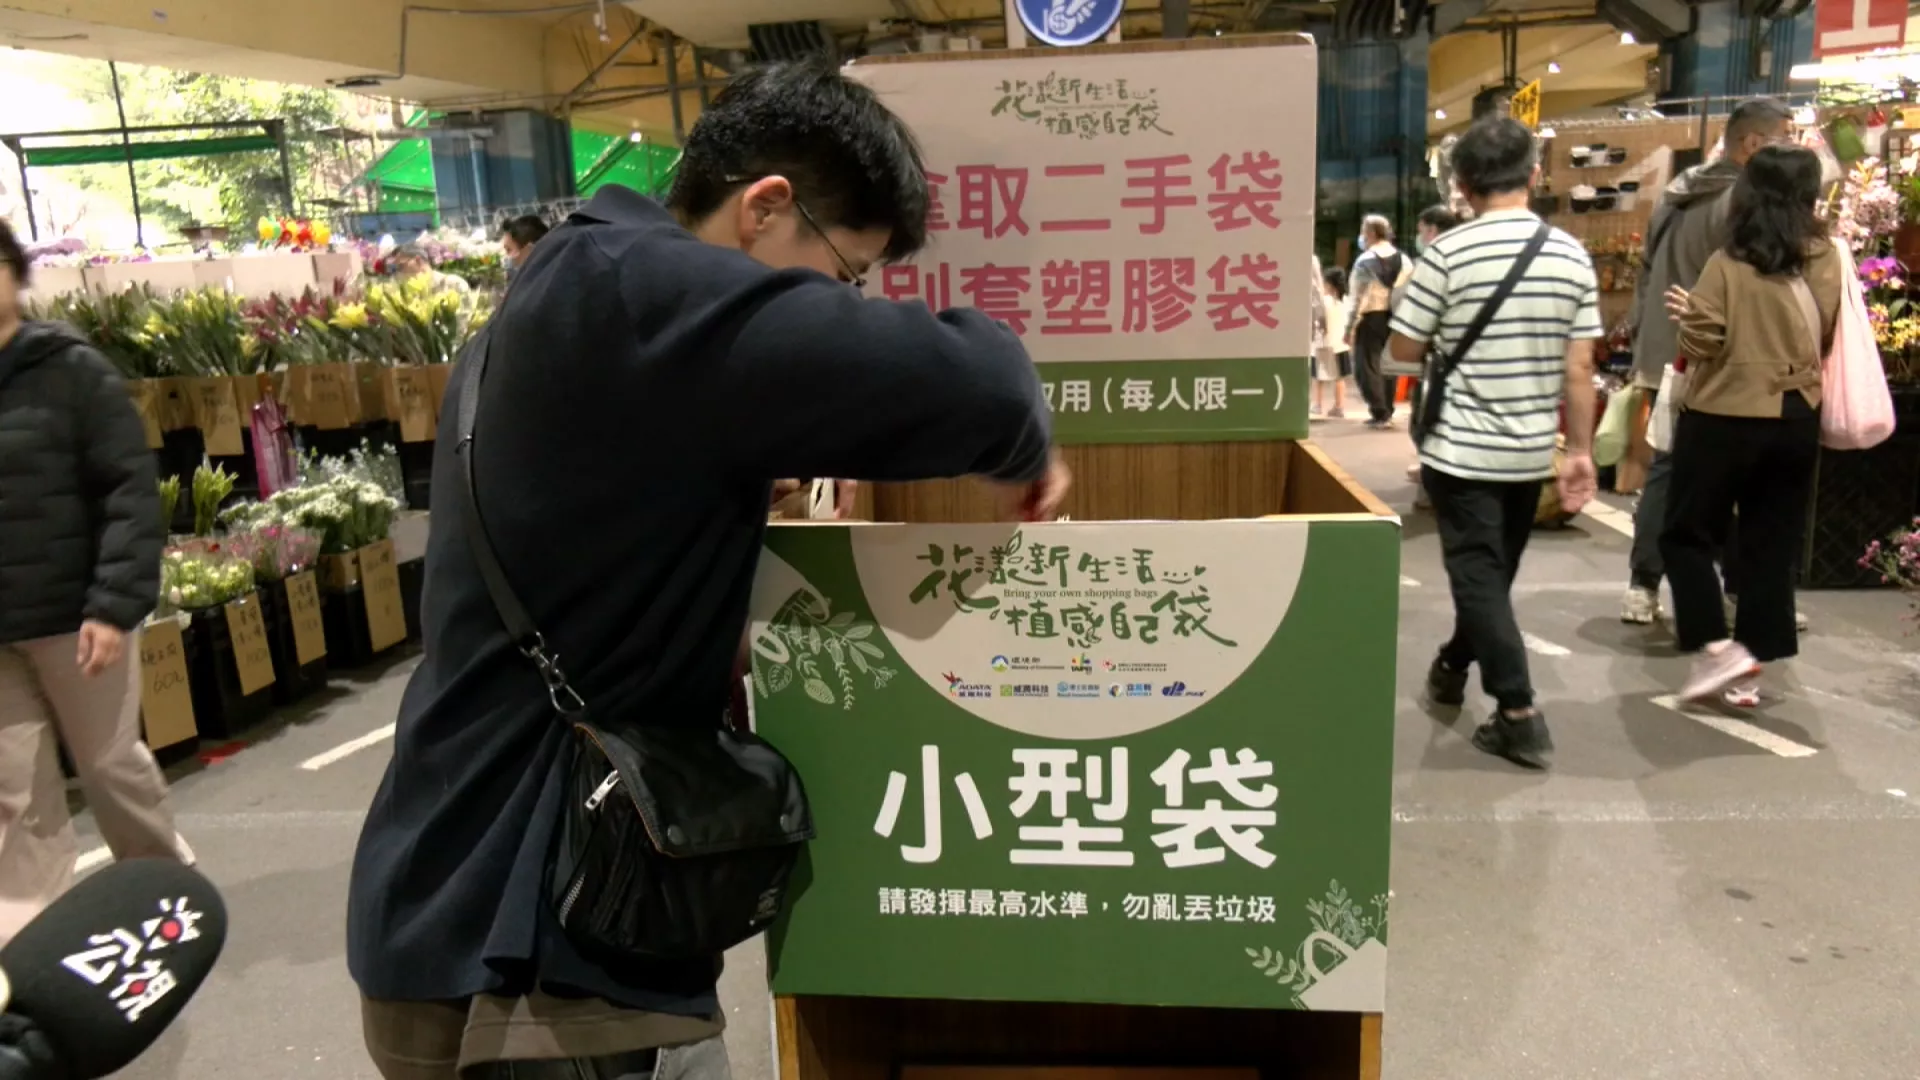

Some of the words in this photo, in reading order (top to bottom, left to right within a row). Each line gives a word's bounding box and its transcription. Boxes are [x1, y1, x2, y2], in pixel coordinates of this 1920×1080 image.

[1003, 588, 1031, 599] Bring
[1034, 590, 1057, 599] your
[1059, 589, 1081, 598] own
[1084, 588, 1132, 599] shopping
[1134, 588, 1158, 599] bags
[873, 744, 1279, 869] 小型袋
[878, 886, 1277, 924] 請發揮最高水準，勿亂丟垃圾
